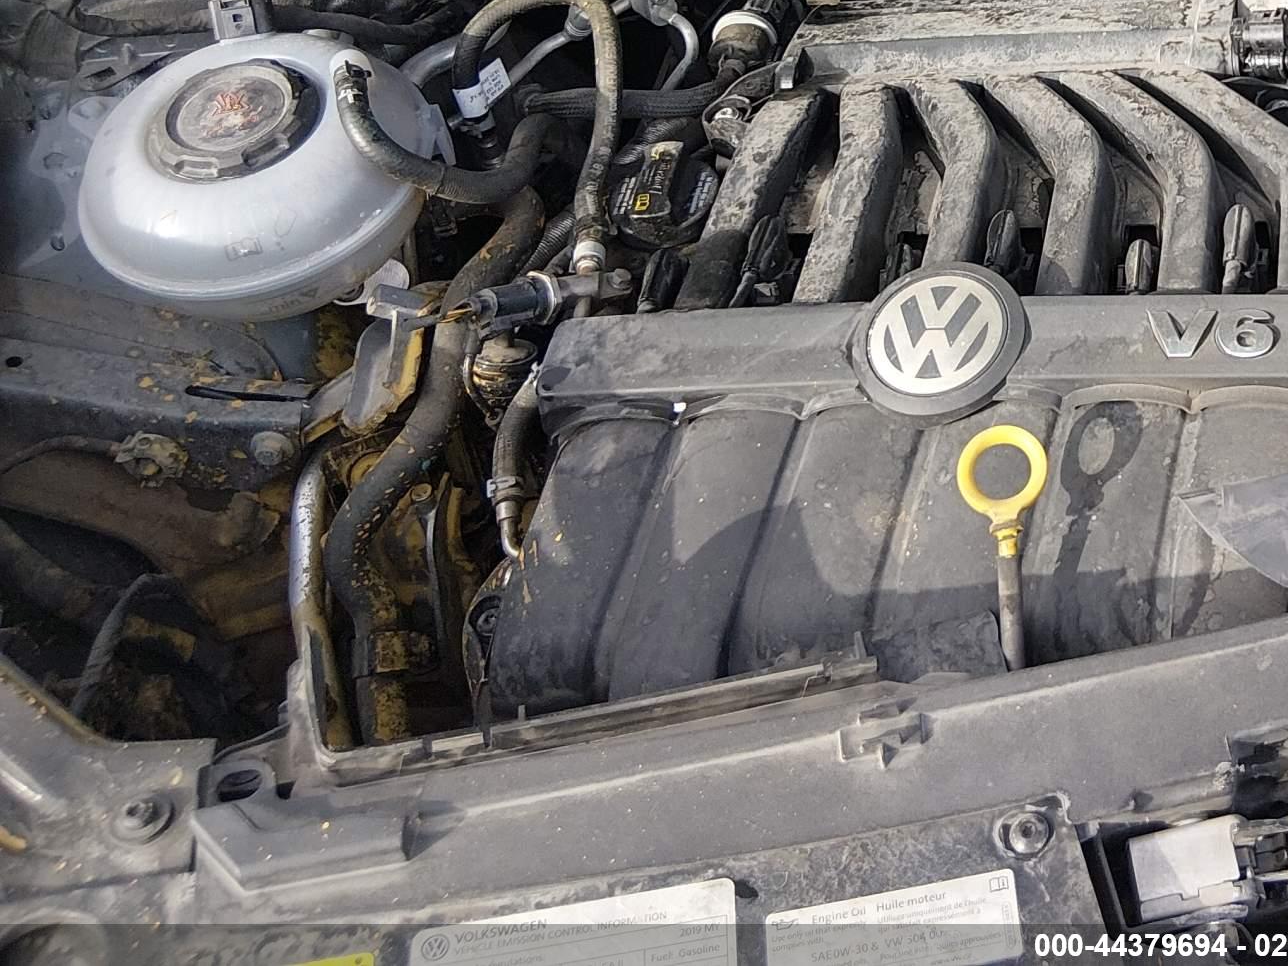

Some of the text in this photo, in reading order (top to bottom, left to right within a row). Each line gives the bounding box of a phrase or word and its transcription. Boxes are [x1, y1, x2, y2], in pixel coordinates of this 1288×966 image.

[1146, 307, 1281, 359] V6
[812, 891, 946, 924] Engine Oil Huile moteur
[953, 902, 964, 910] de
[454, 918, 547, 944] VOLKSWAGEN
[497, 934, 545, 948] EMISSION
[548, 925, 592, 940] CONTROL
[680, 924, 701, 937] 2019
[787, 930, 803, 940] only
[885, 936, 903, 948] VW
[651, 944, 720, 962] Fuel: Gasoline
